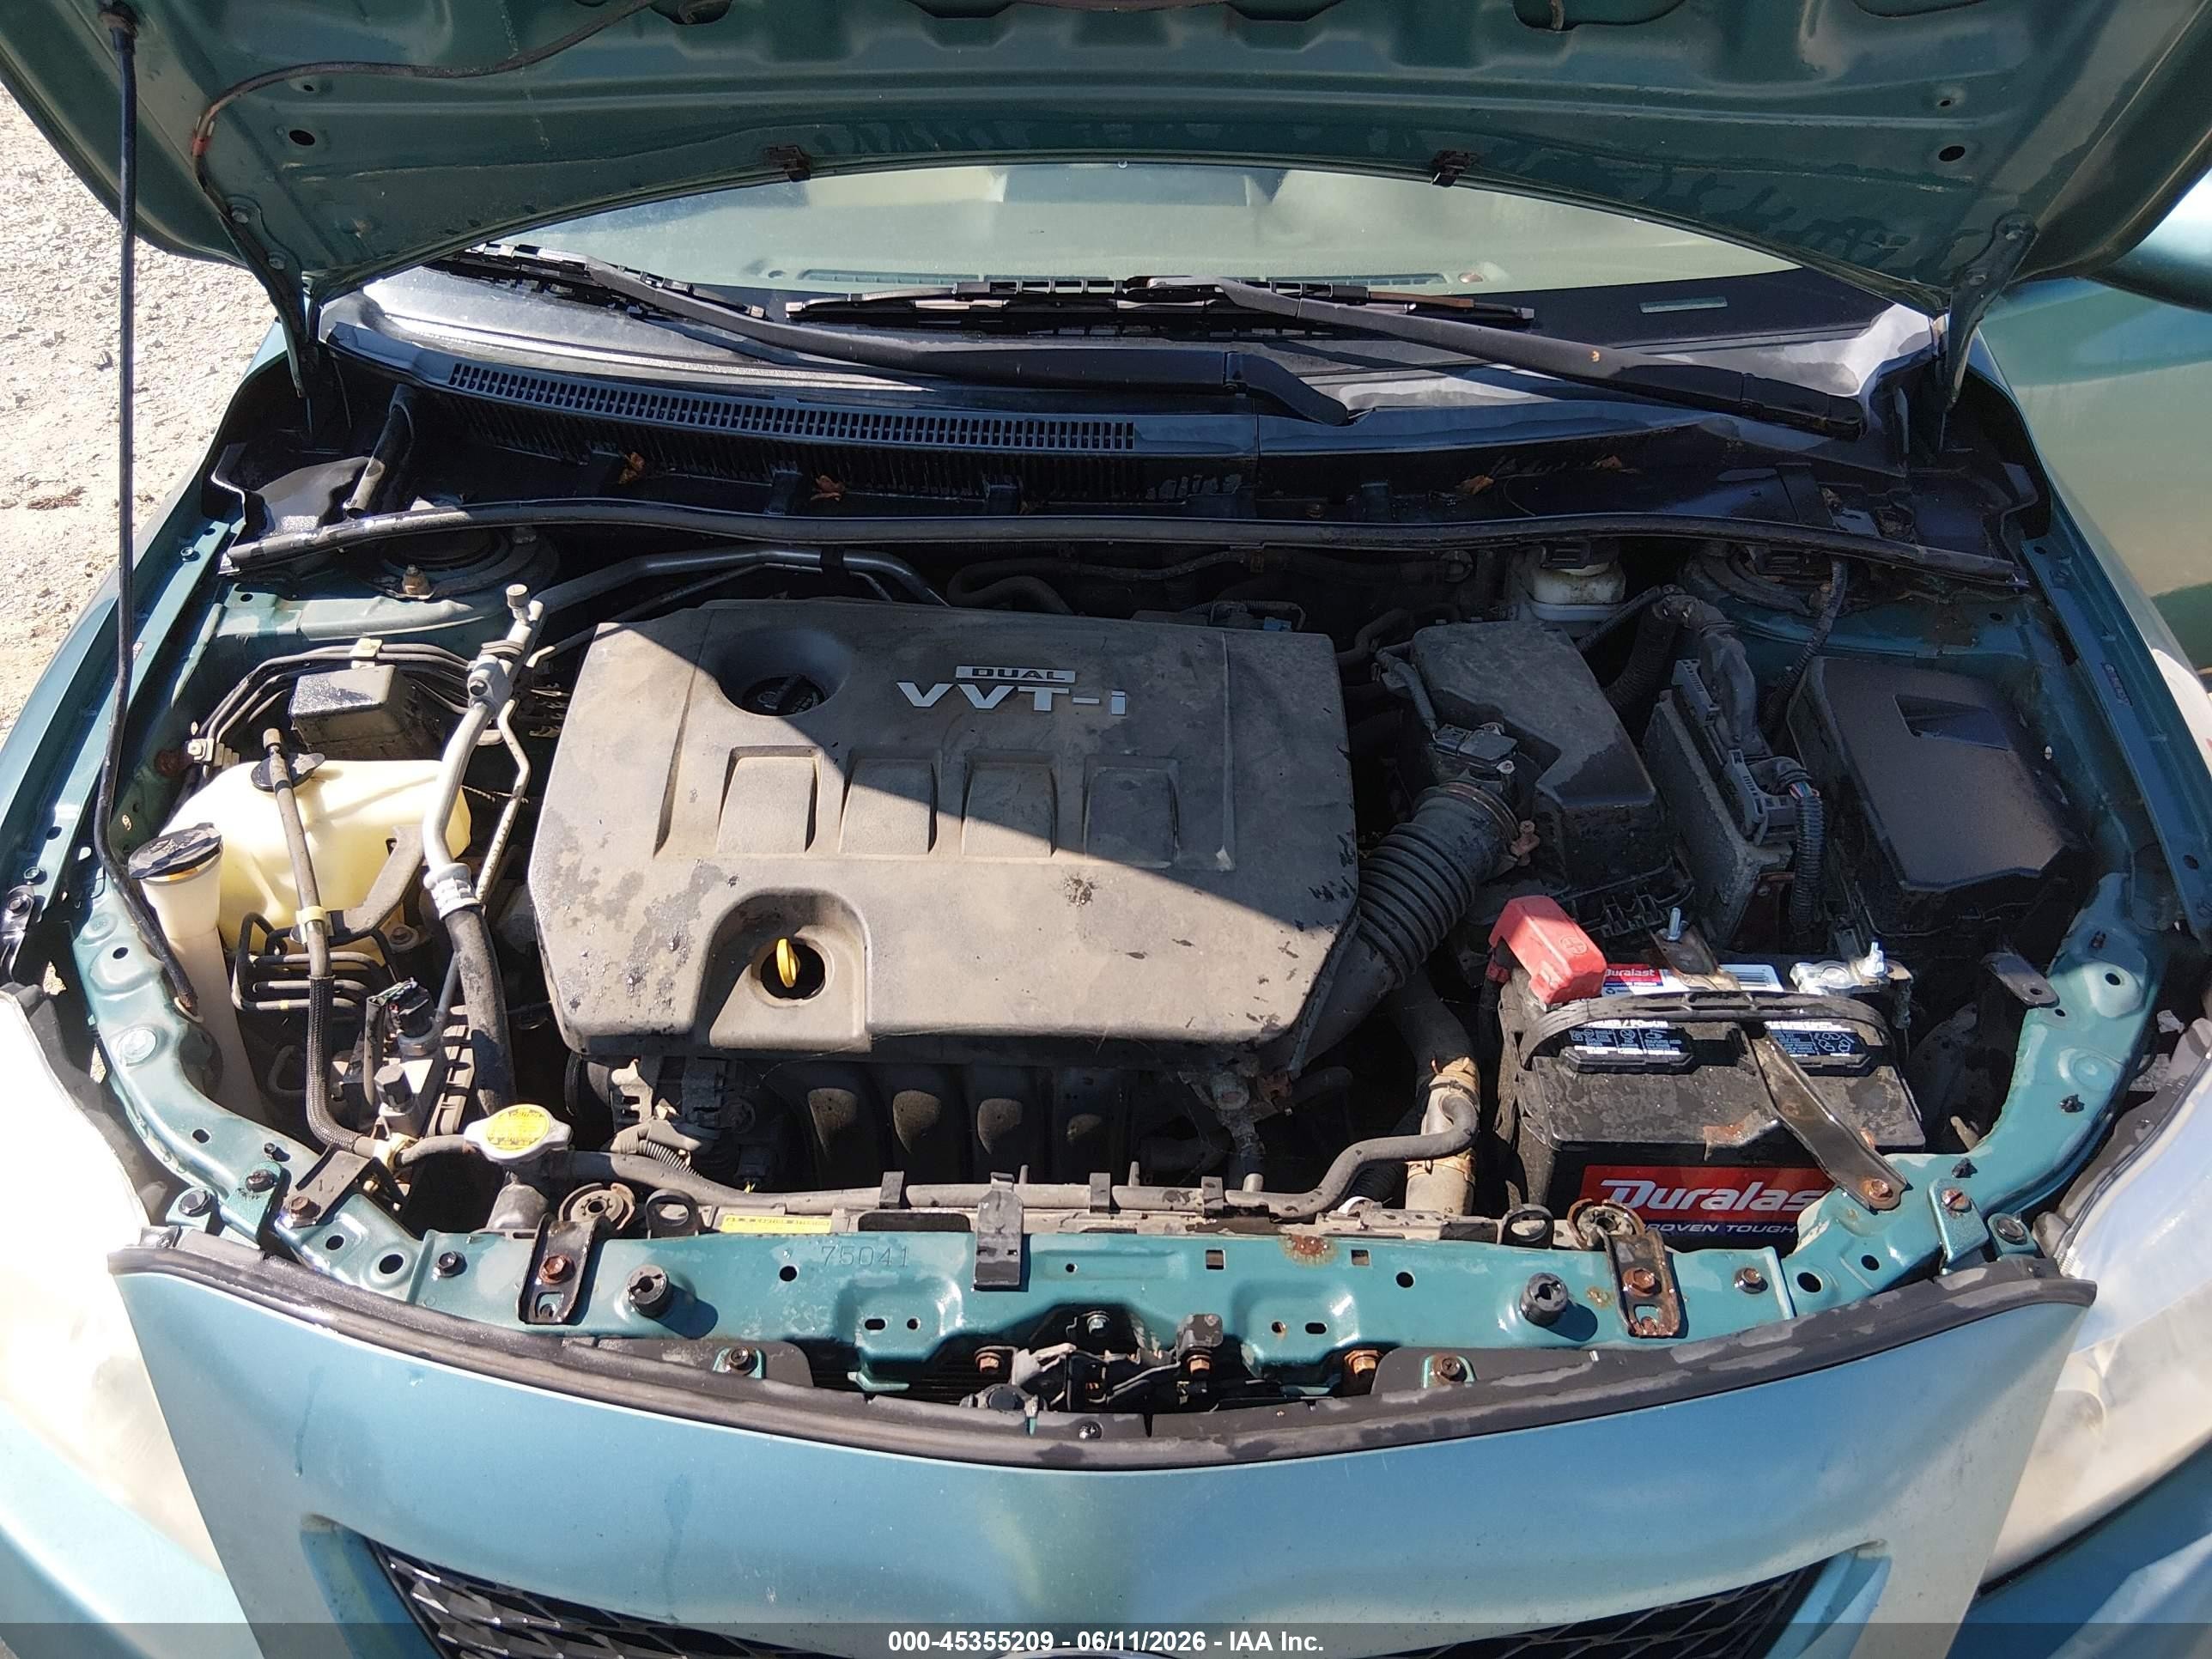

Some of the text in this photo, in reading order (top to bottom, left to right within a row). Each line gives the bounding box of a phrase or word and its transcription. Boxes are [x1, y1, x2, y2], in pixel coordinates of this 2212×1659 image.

[971, 668, 1066, 680] DUAL
[896, 682, 1127, 715] VVT-i
[1606, 969, 1655, 977] Duralast
[1601, 1180, 1826, 1212] Duralas
[1644, 1223, 1796, 1234] ROVEN TOUGH
[821, 1245, 908, 1267] 75041
